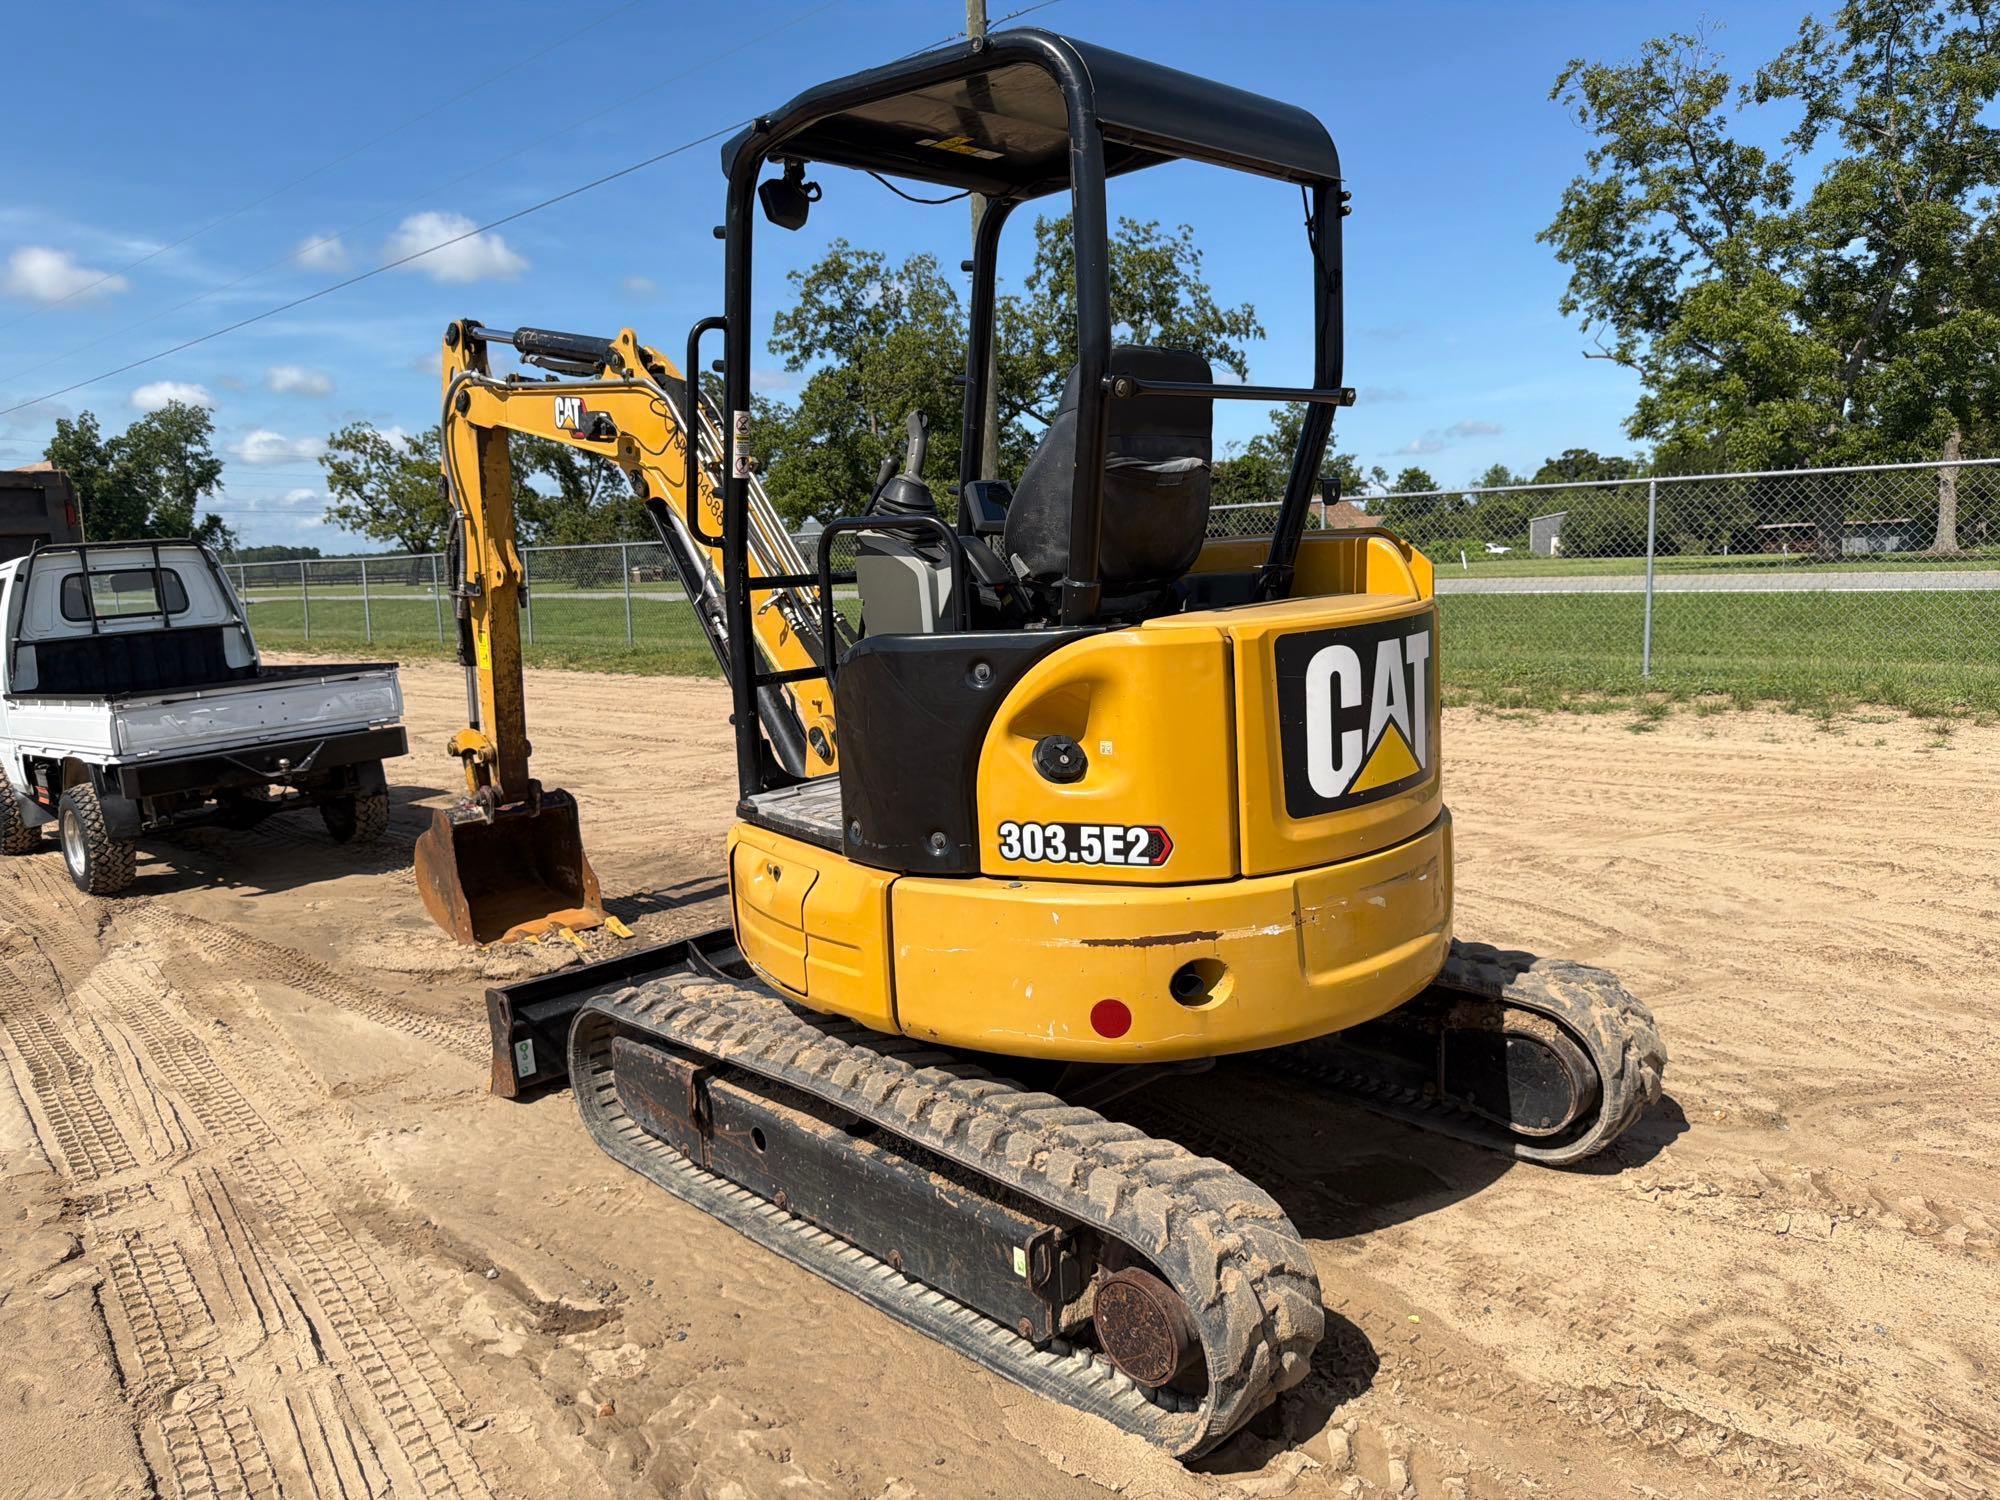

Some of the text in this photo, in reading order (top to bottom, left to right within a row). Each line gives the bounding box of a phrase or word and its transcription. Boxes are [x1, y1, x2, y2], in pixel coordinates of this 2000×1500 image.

[555, 396, 580, 429] CAT
[1305, 630, 1429, 798] CAT
[999, 822, 1150, 864] 303.5E2
